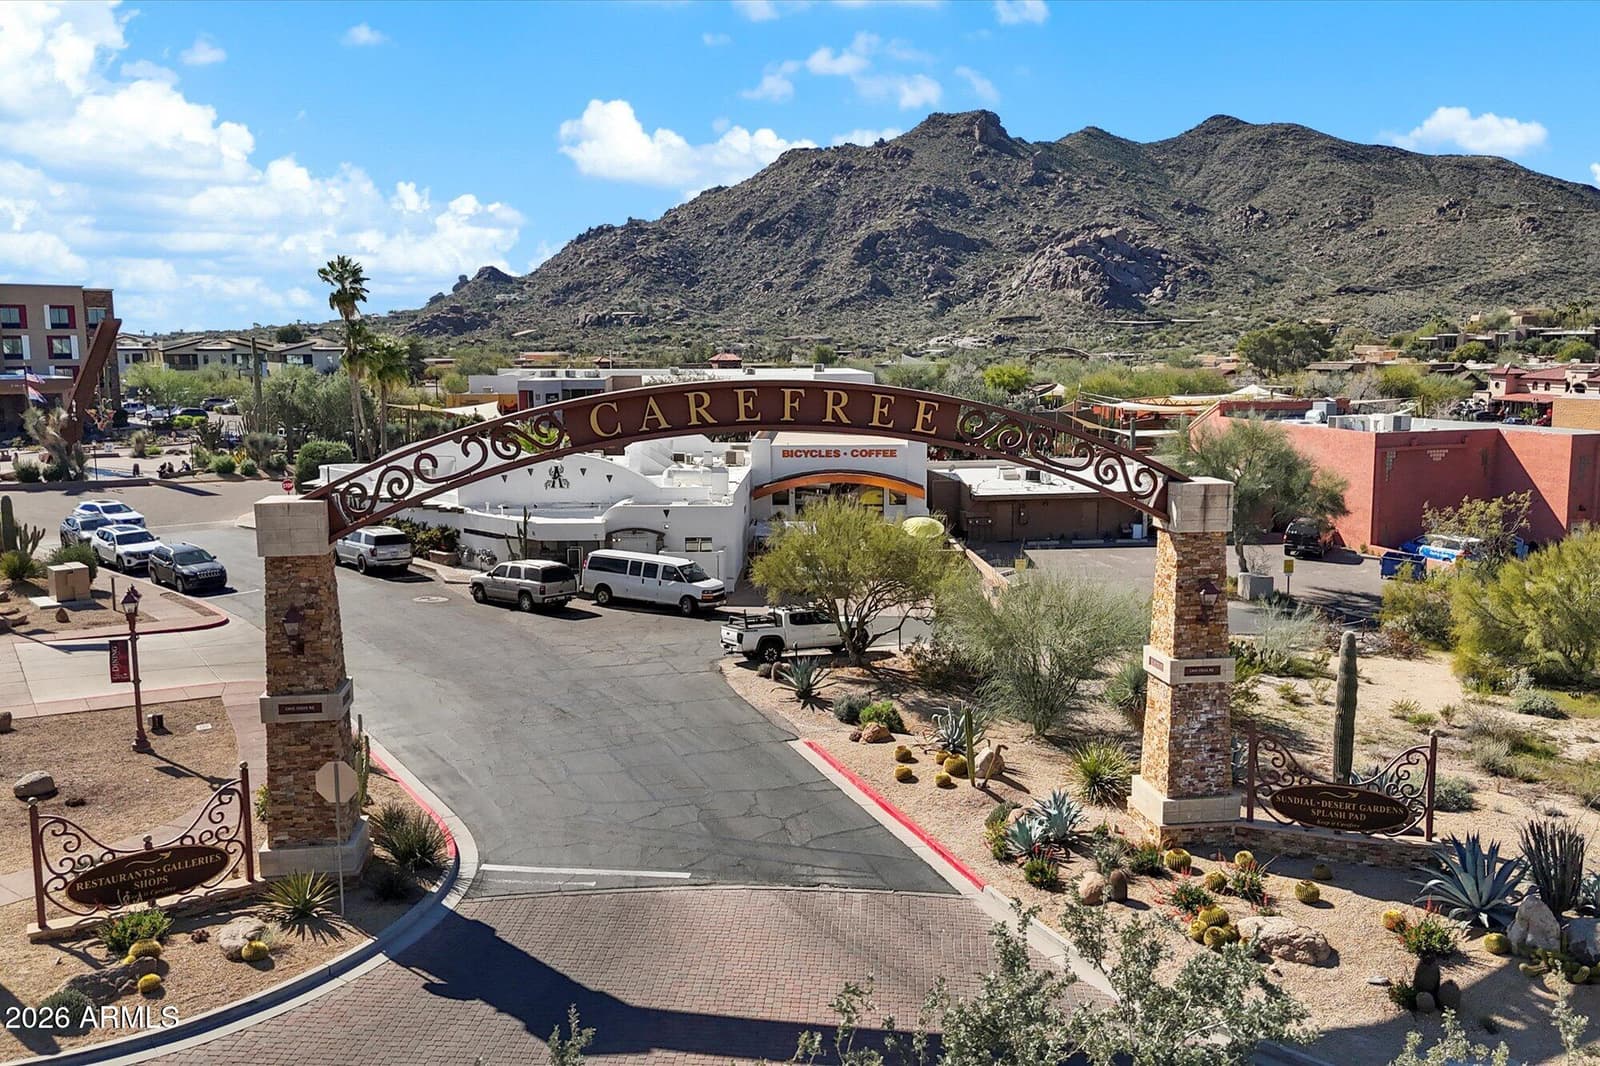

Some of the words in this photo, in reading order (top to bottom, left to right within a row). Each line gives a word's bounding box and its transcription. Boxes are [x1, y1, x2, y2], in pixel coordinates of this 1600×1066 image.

[589, 387, 939, 438] CAREFREE
[782, 449, 841, 458] BICYCLES
[850, 449, 897, 458] COFFEE
[111, 645, 120, 672] DINING
[1275, 794, 1317, 807] SUNDIAL
[1321, 800, 1357, 811] DESERT
[1359, 804, 1404, 815] GARDENS
[1311, 808, 1346, 819] SPLASH
[1348, 812, 1367, 821] PAD
[75, 868, 156, 892] RESTAURANTS
[163, 853, 222, 873] GALLERIES
[133, 875, 169, 890] SHOPS
